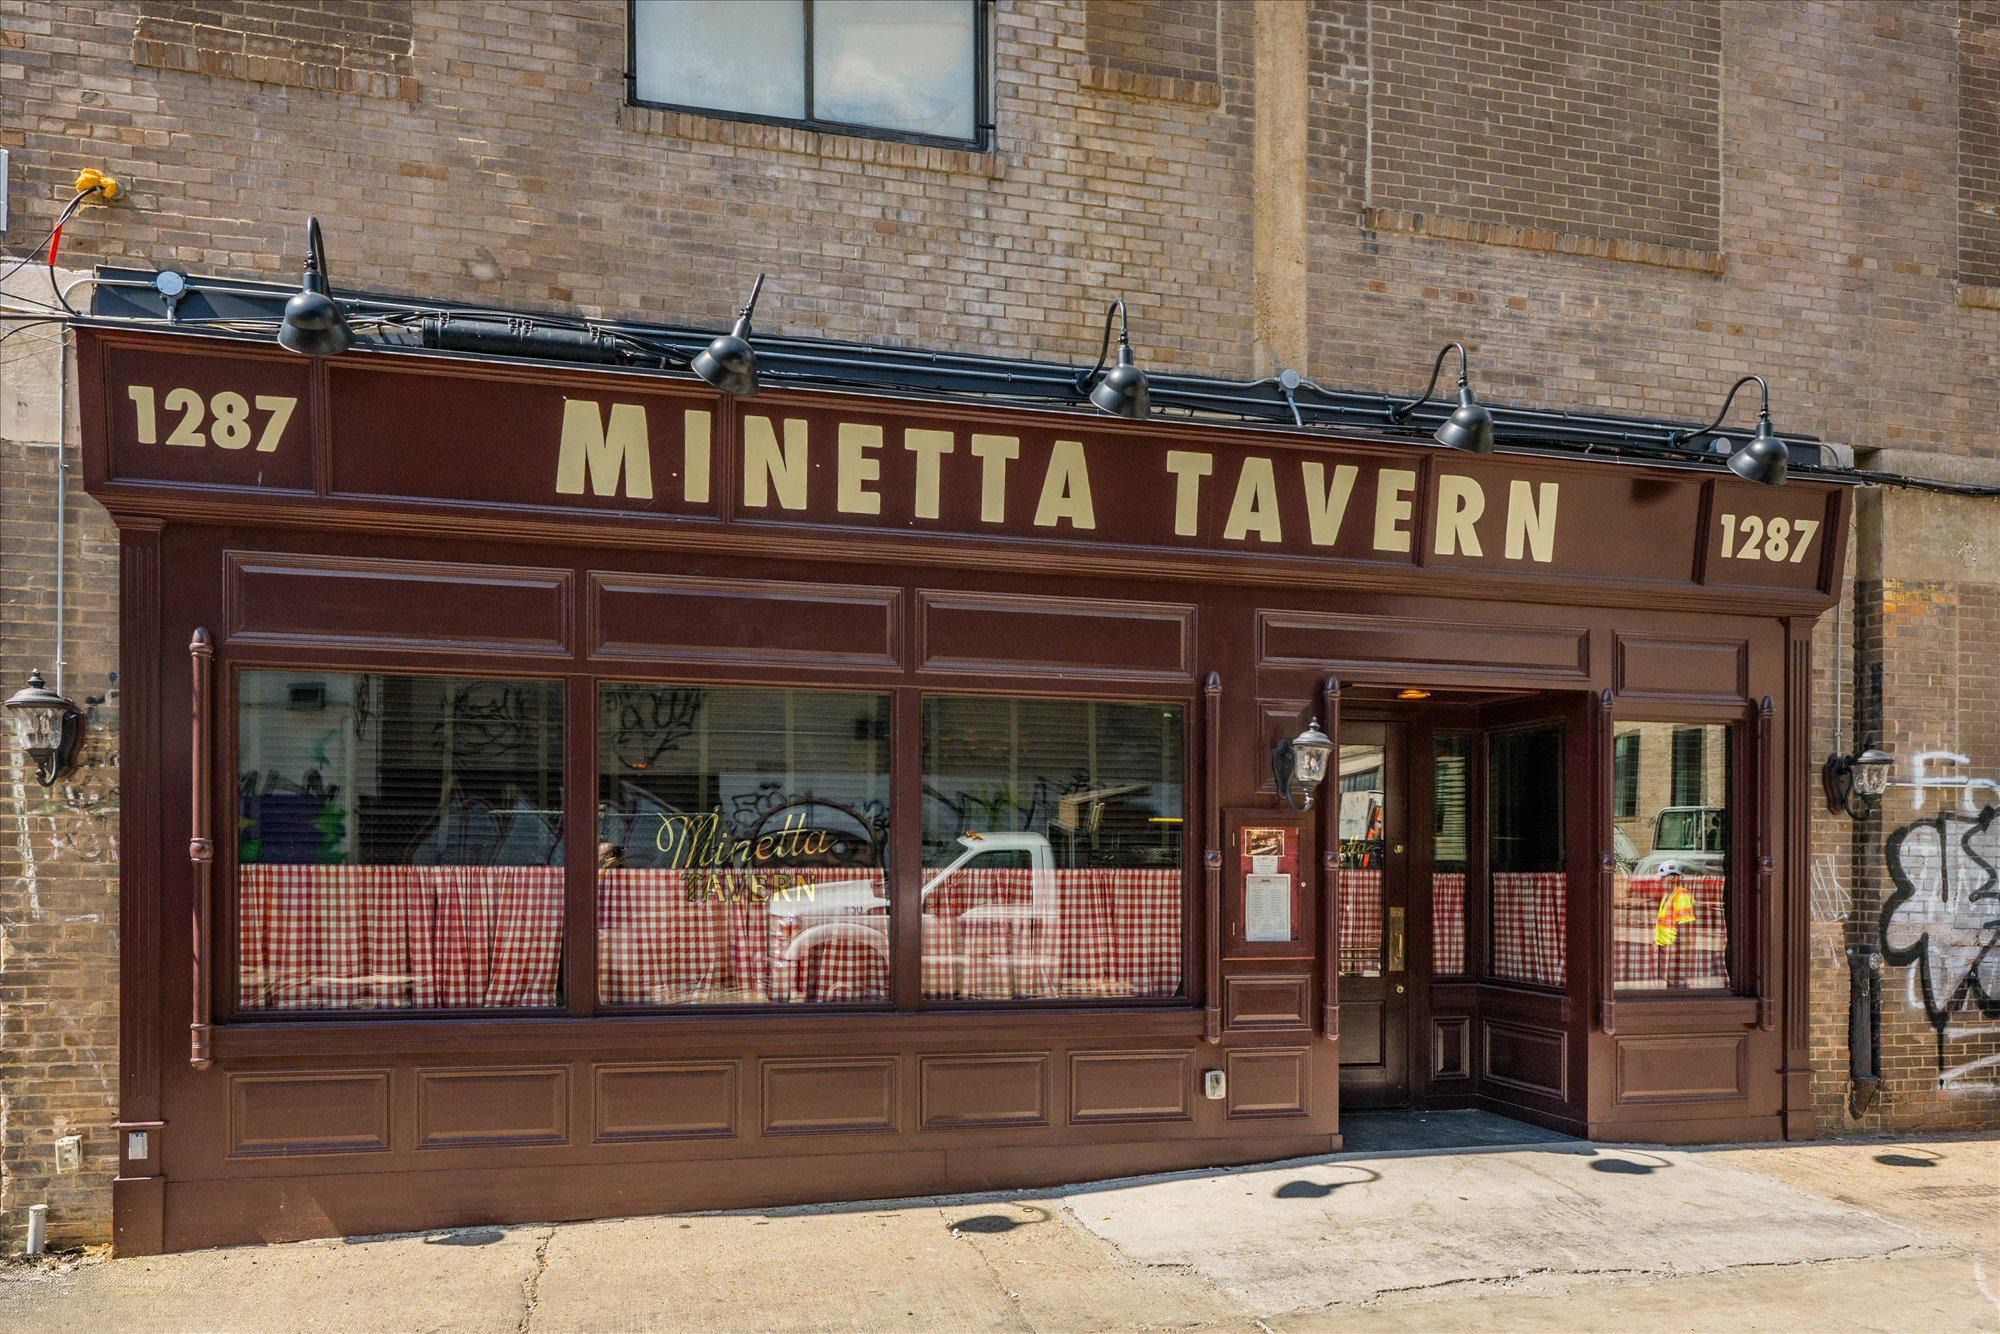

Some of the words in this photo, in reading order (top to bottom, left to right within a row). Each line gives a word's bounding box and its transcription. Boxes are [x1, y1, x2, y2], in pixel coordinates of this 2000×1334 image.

[128, 385, 298, 453] 1287
[555, 399, 1096, 530] MINETTA
[1166, 450, 1559, 563] TAVERN
[1720, 513, 1820, 564] 1287
[656, 812, 839, 869] Minetta
[680, 872, 817, 903] TAVERN
